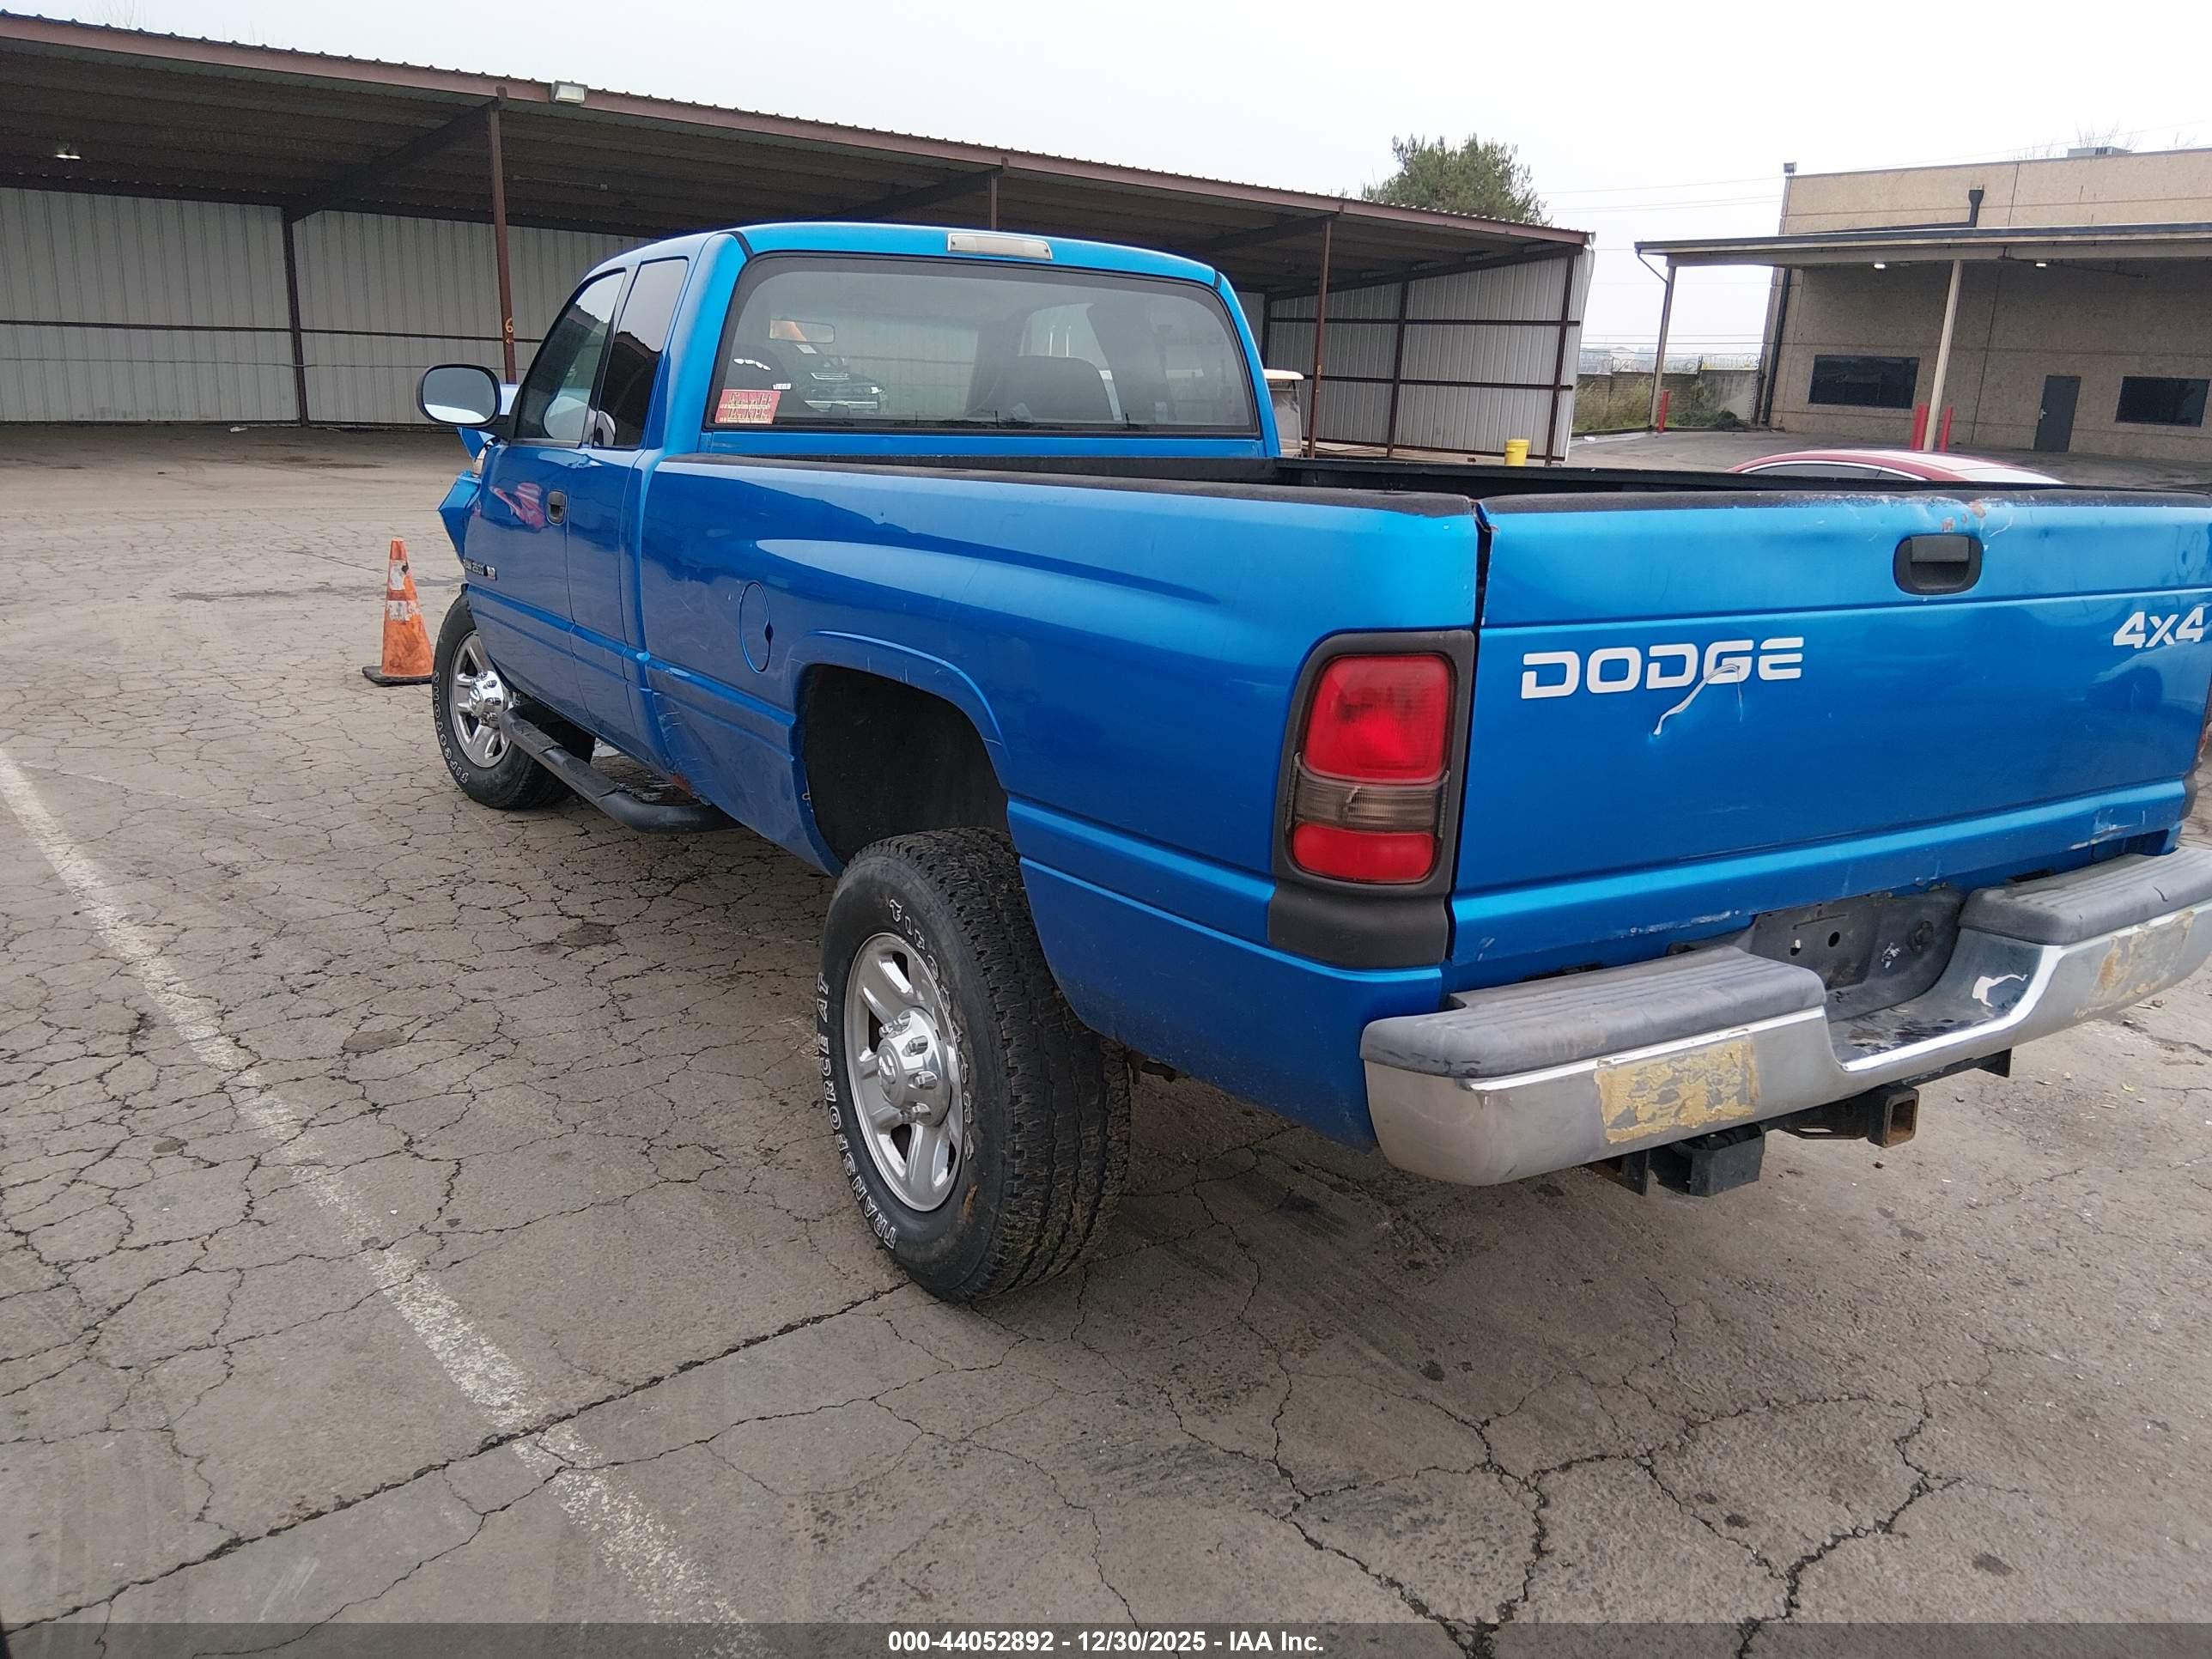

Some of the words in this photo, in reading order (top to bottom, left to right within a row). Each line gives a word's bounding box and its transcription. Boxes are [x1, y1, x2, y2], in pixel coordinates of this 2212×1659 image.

[505, 316, 514, 334] 6
[1521, 636, 1804, 699] DODGE
[816, 971, 831, 1024] AT
[817, 1031, 896, 1250] TRANSFORCE
